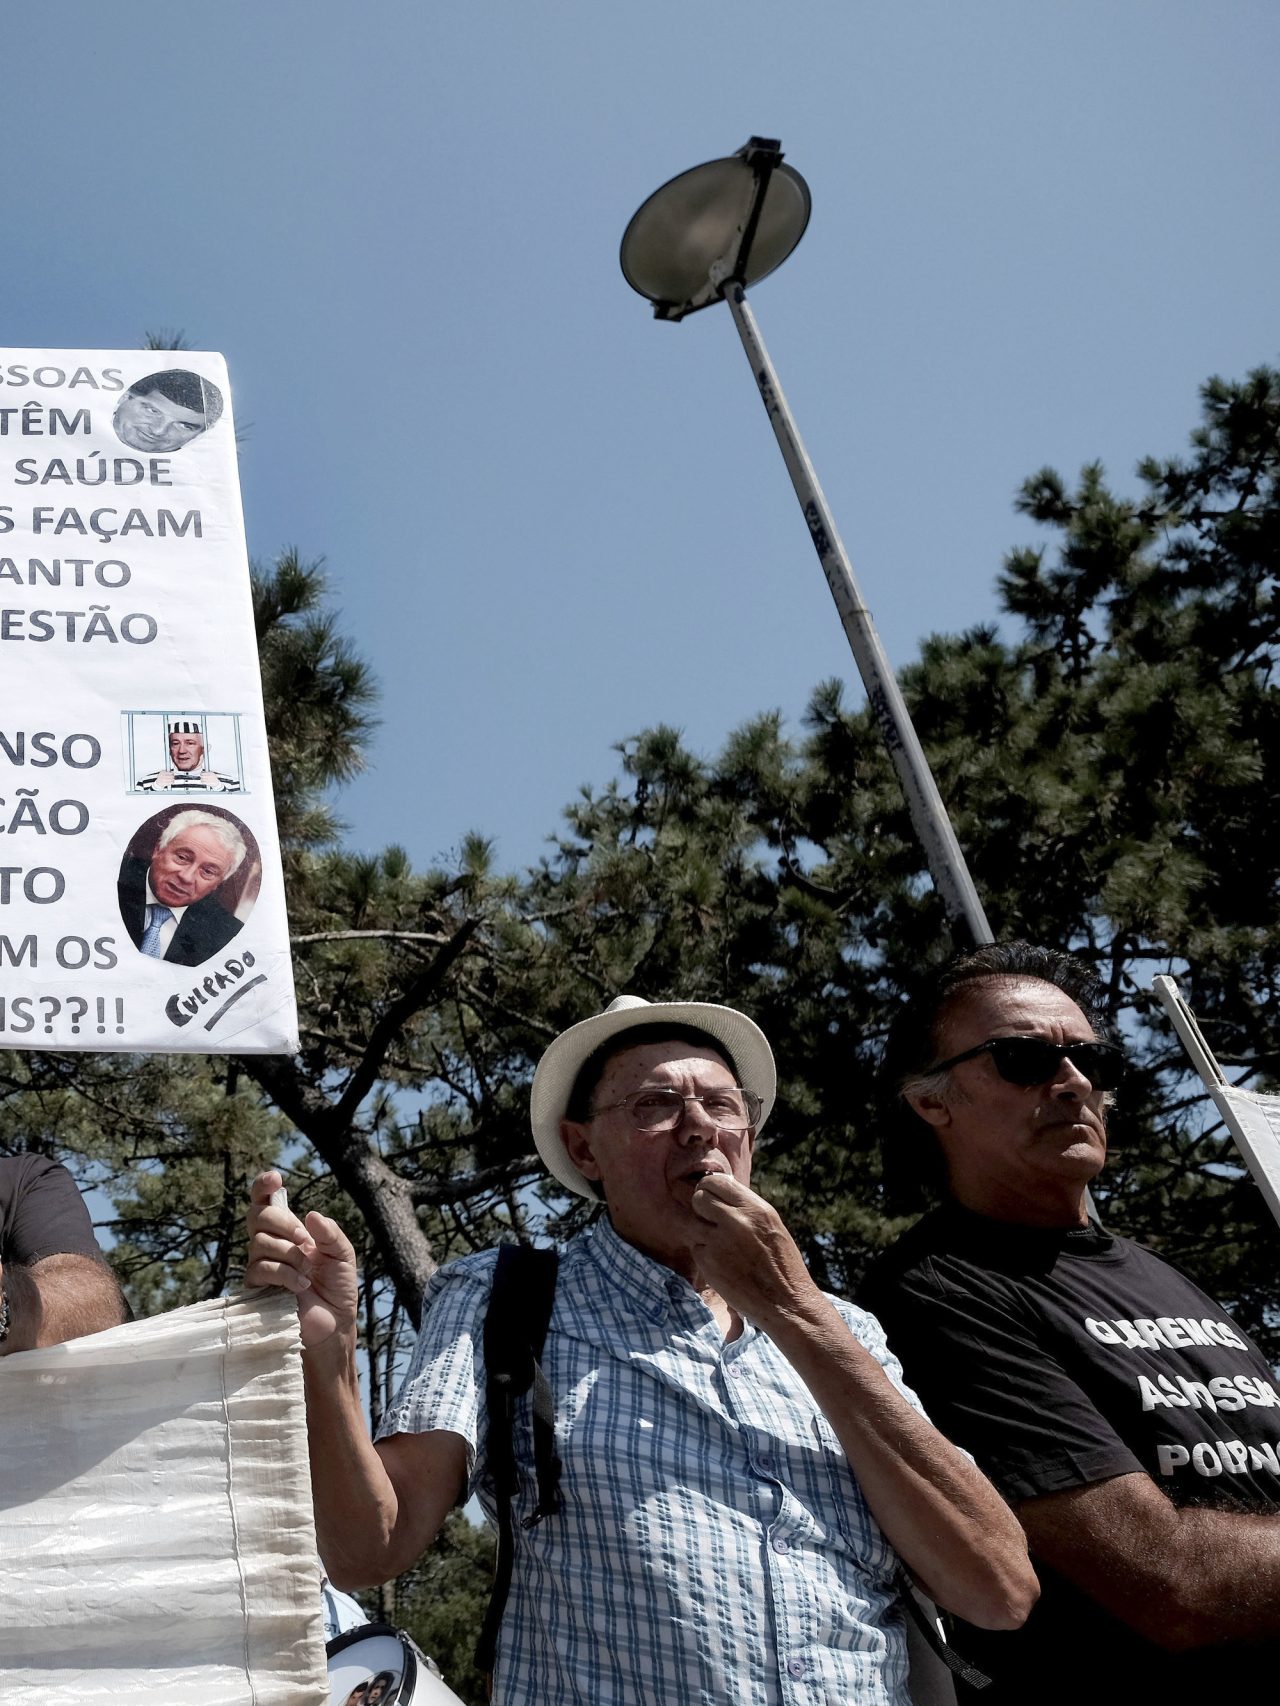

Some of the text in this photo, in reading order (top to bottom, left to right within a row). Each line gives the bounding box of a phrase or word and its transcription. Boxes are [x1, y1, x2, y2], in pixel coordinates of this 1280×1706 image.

[15, 451, 172, 486] SAÚDE
[33, 507, 202, 543] FAÇAM
[56, 936, 117, 969] OS
